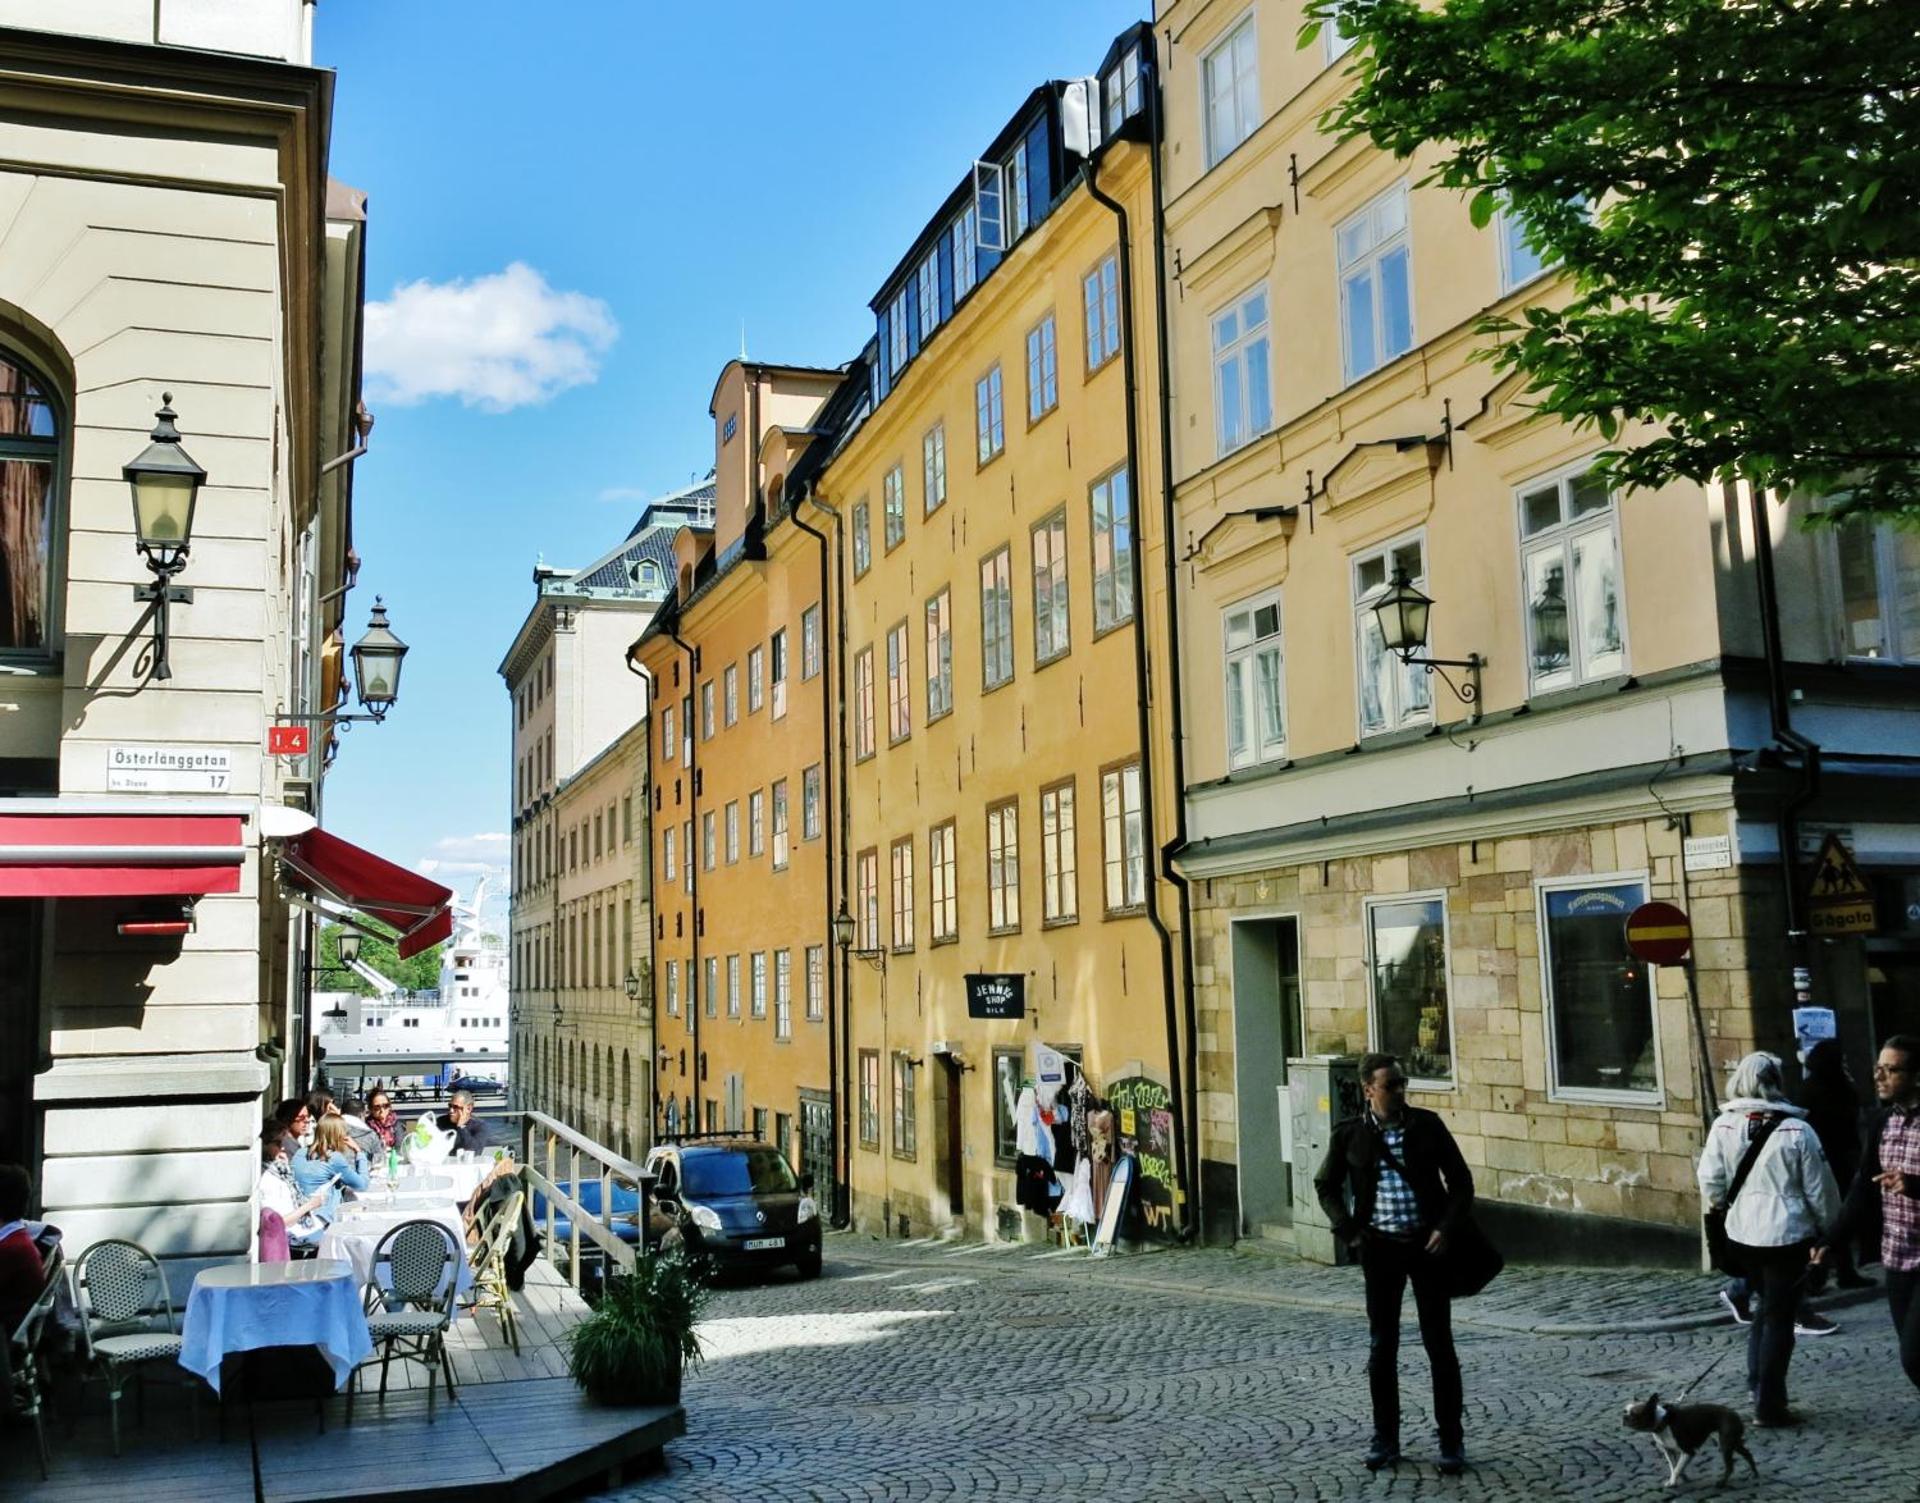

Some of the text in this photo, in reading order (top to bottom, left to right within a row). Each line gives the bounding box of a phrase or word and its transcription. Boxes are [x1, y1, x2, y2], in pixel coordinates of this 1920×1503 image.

[210, 775, 225, 788] 17
[1813, 911, 1872, 928] Gågata
[985, 996, 1006, 1005] SHOP
